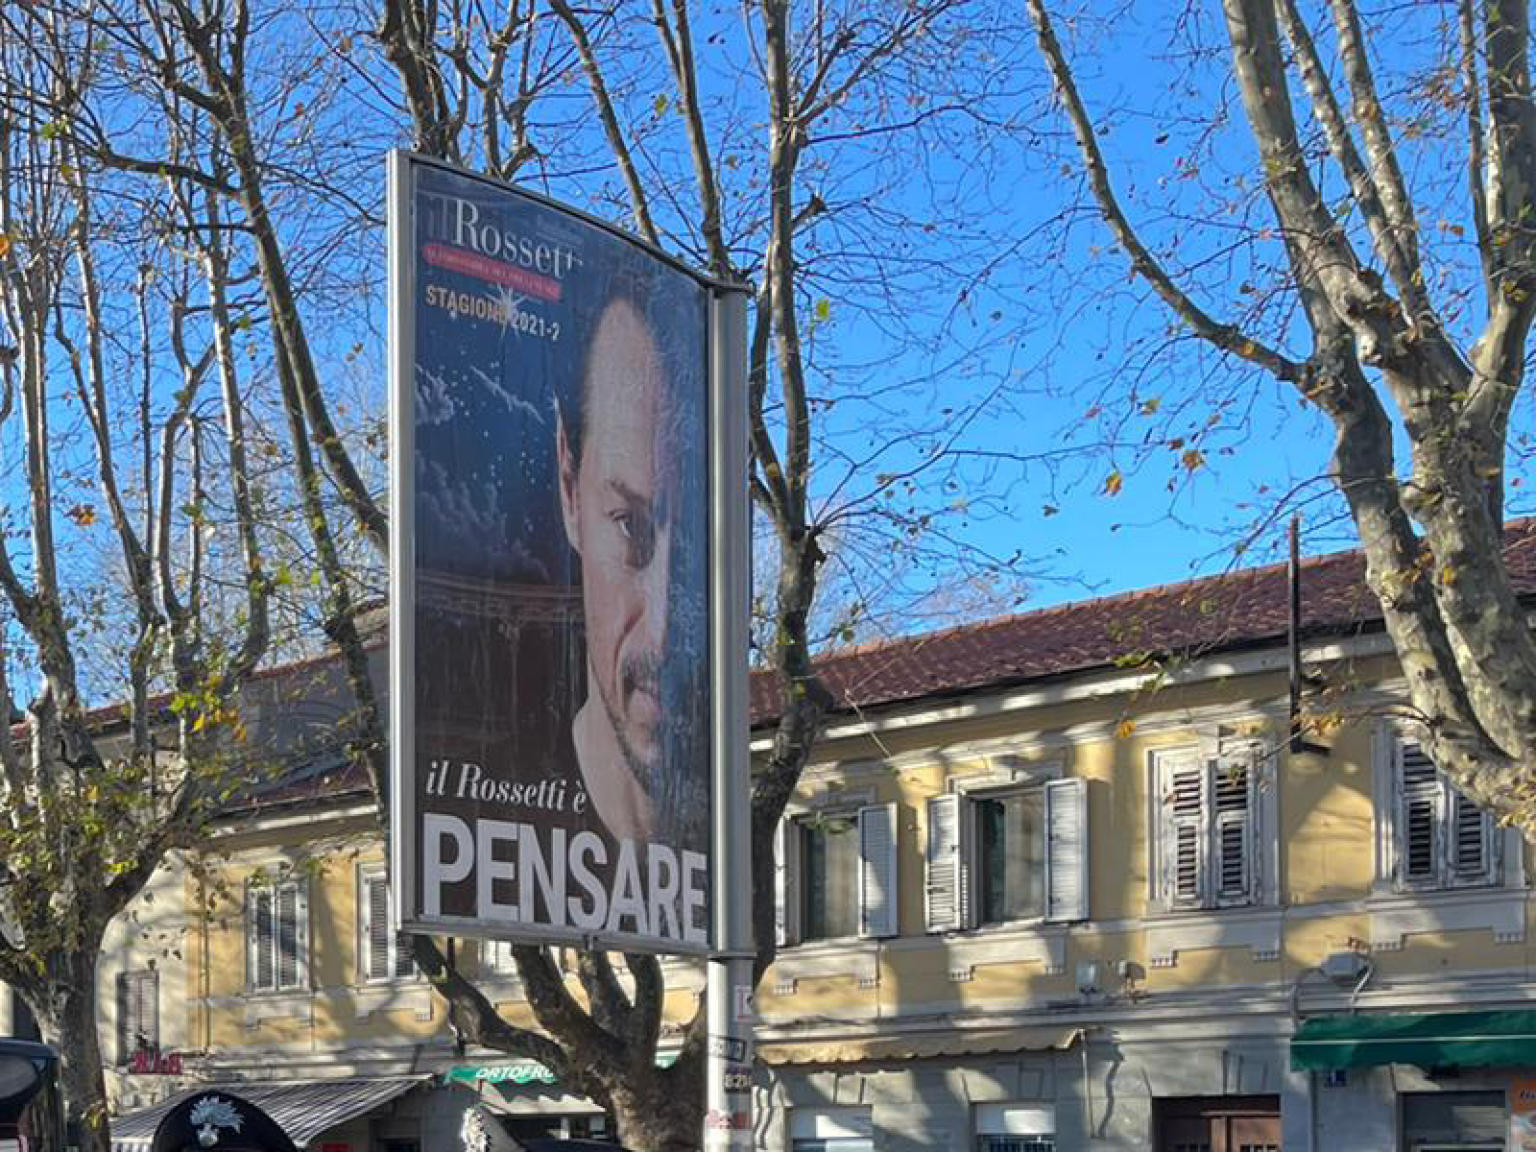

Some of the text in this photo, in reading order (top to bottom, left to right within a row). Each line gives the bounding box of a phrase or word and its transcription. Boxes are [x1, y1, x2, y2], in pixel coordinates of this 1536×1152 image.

[426, 759, 587, 816] il Rossetti è
[423, 813, 708, 946] PENSARE
